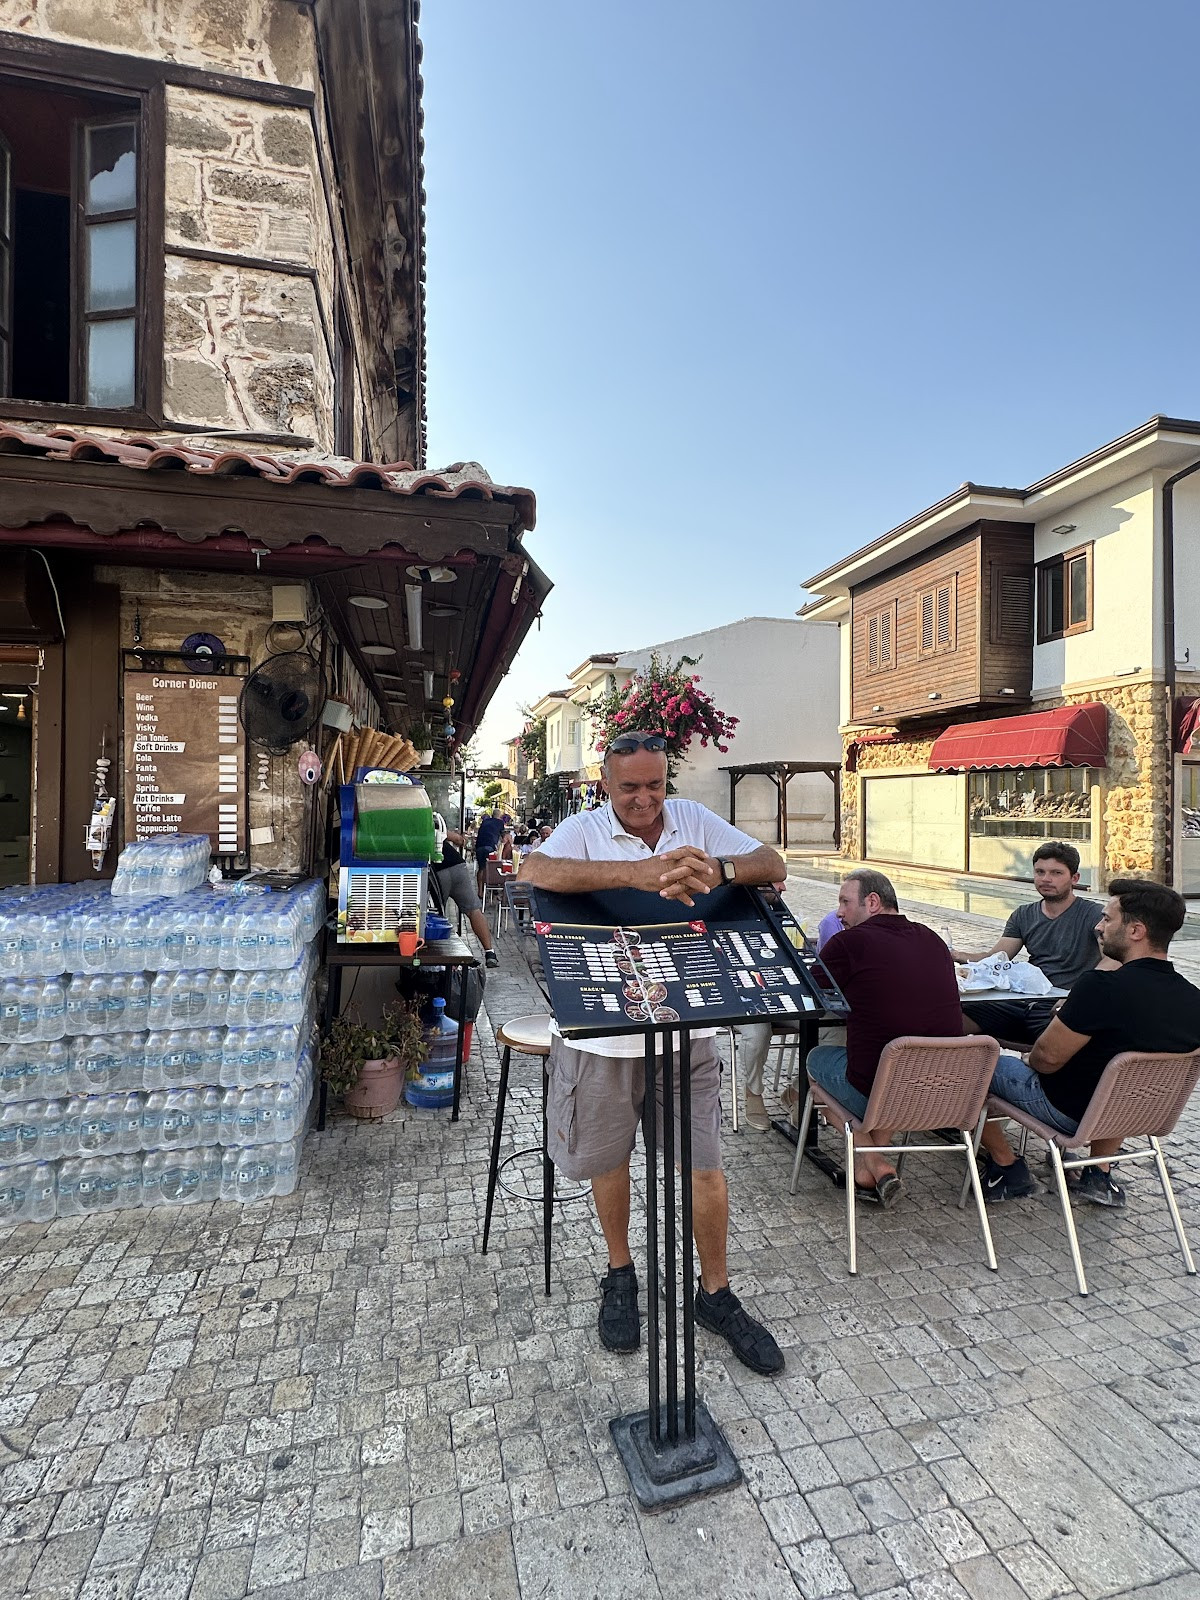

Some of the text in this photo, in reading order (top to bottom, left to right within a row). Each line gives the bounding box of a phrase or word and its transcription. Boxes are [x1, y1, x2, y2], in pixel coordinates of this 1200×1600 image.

[152, 677, 218, 690] Corner Döner
[135, 693, 154, 701] Beer
[135, 703, 155, 712] Wine
[135, 713, 159, 722] Vodka
[135, 723, 157, 733] Visky
[149, 733, 169, 742] Tonic
[136, 743, 179, 751] Soft Drinks
[135, 753, 153, 762] Cola
[135, 763, 158, 772] Fanta
[135, 773, 156, 782] Tonic
[135, 784, 160, 793] Sprite
[135, 795, 175, 803] Hot Drinks
[135, 804, 161, 813] Coffee
[135, 814, 183, 823] Coffee Latte
[135, 824, 178, 834] Cappuccino
[135, 834, 149, 842] Tea
